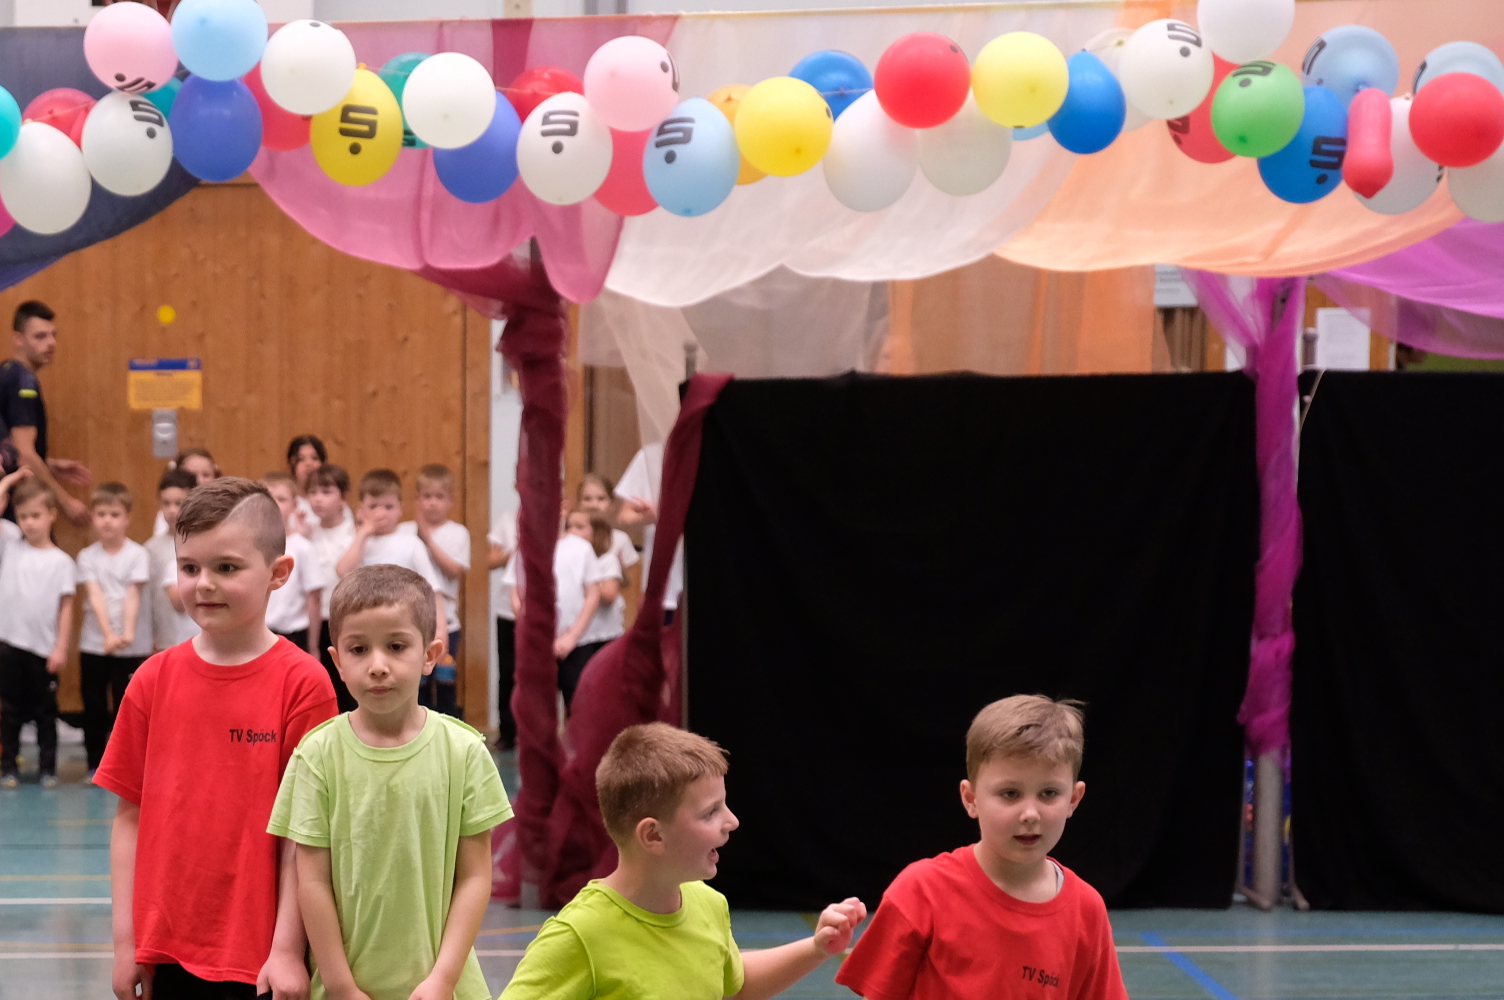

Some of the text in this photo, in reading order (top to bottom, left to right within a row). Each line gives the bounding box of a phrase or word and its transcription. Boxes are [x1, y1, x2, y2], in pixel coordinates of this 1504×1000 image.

[229, 729, 277, 746] TV Spöck
[1022, 966, 1036, 981] TV
